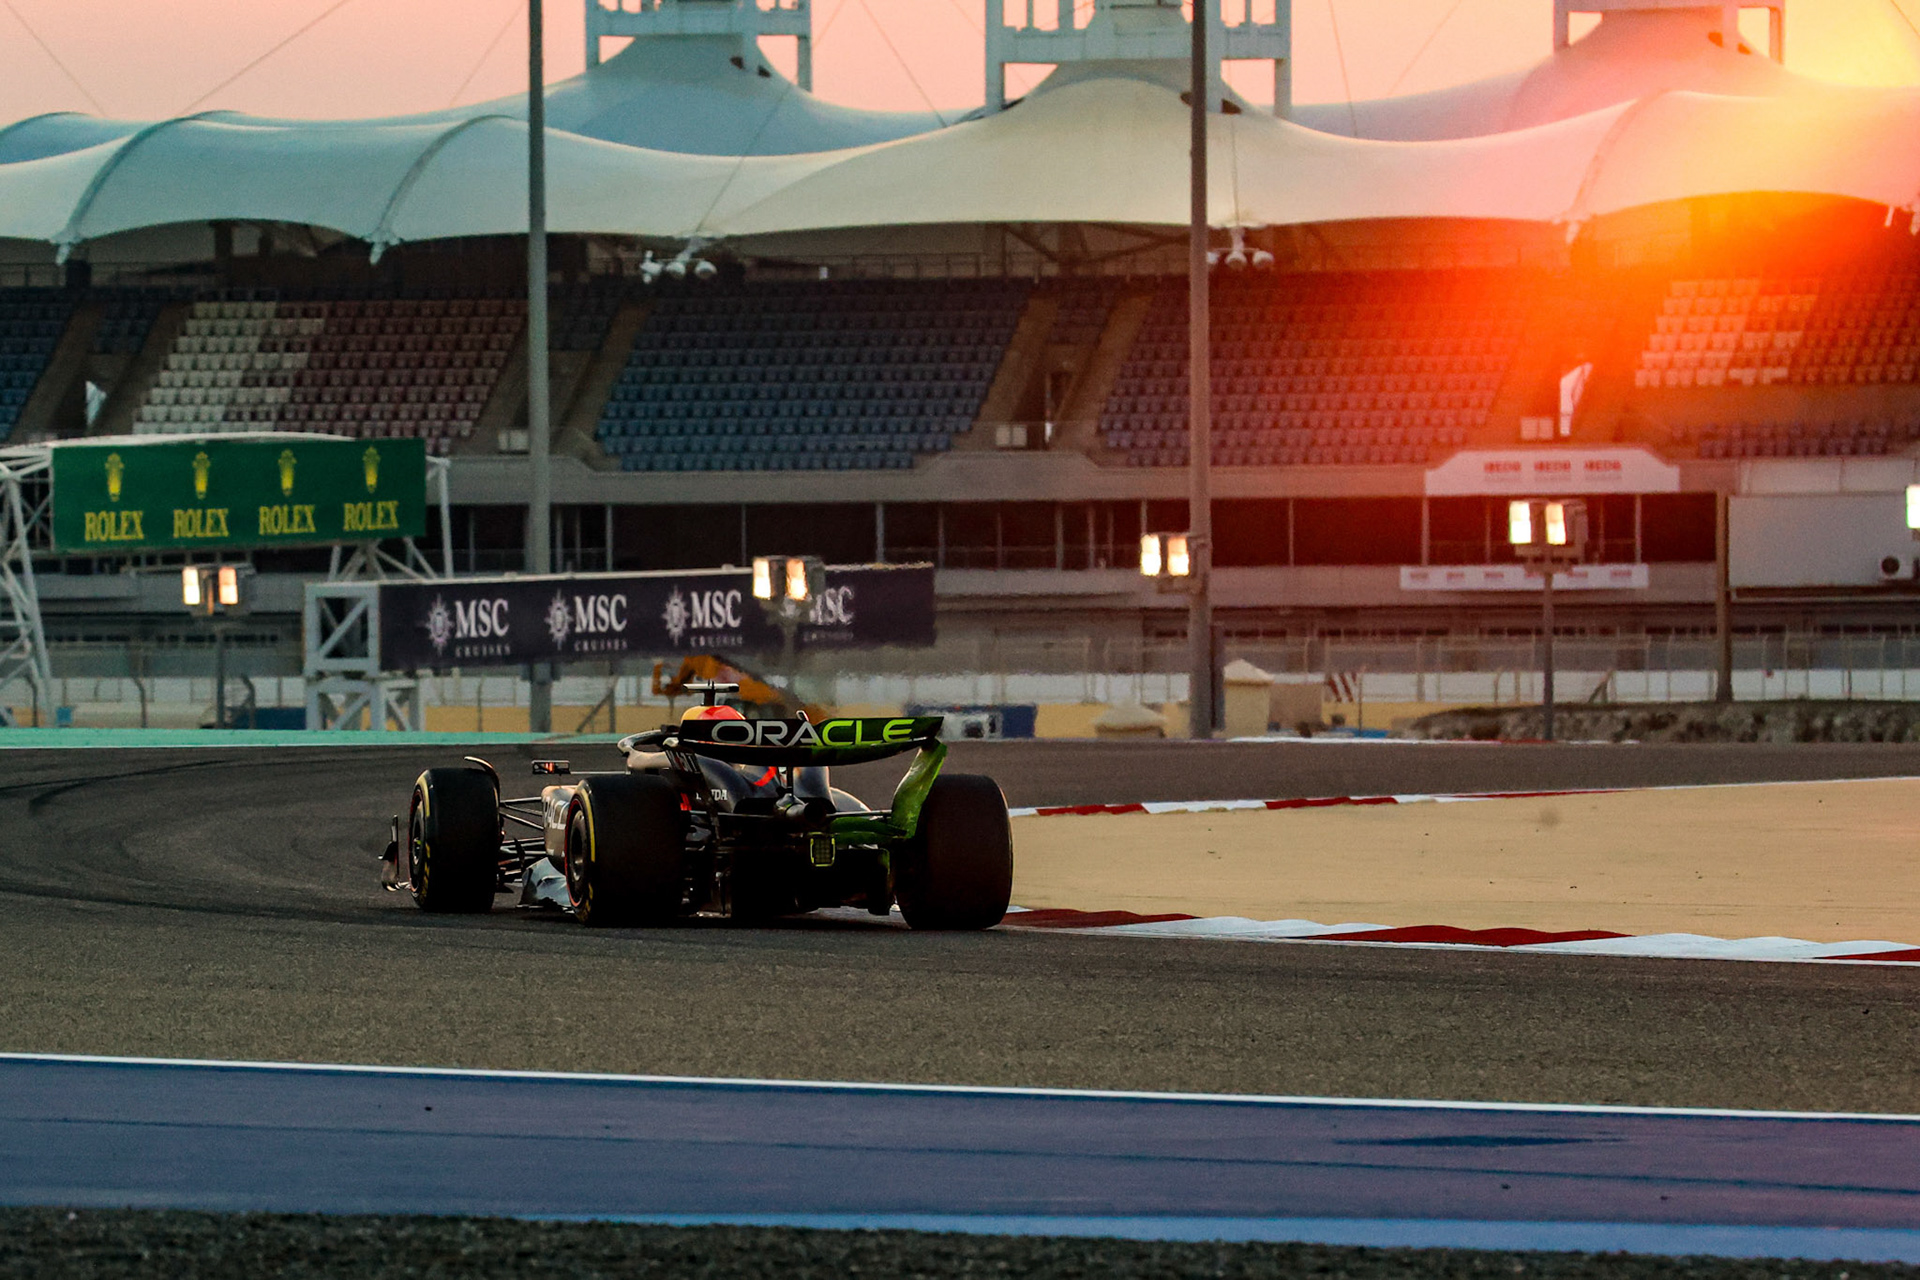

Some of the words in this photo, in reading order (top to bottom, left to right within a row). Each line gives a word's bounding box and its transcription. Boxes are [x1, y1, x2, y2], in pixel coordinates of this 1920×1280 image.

[84, 510, 145, 542] ROLEX
[172, 508, 230, 538] ROLEX
[258, 504, 316, 535] ROLEX
[342, 500, 399, 531] ROLEX
[454, 598, 510, 639] MSC
[574, 594, 628, 633] MSC
[690, 589, 742, 628] MSC
[711, 718, 915, 747] ORACLE
